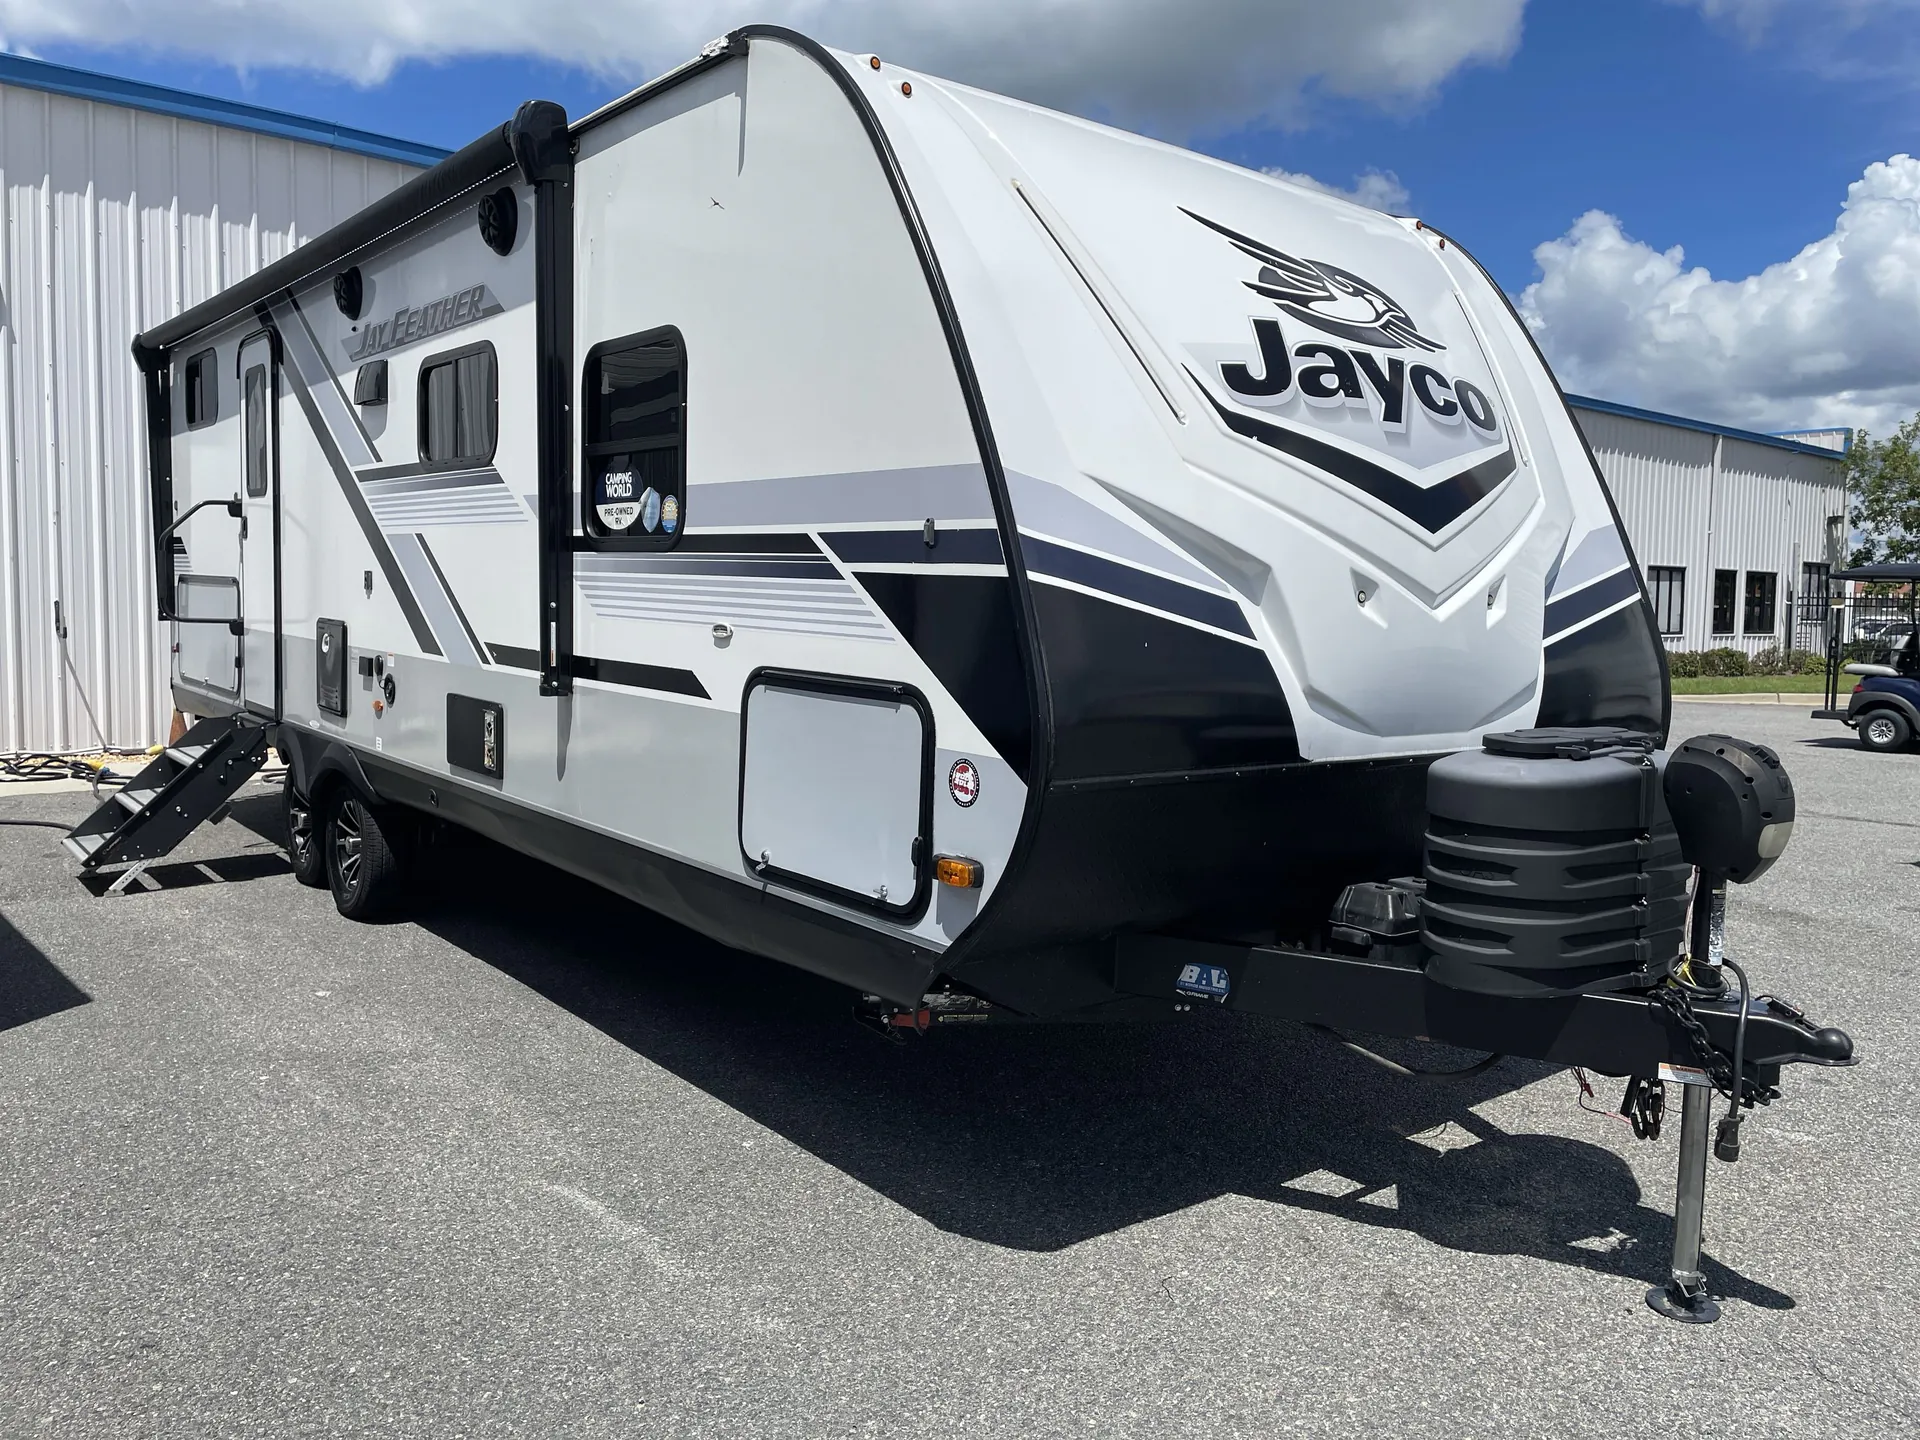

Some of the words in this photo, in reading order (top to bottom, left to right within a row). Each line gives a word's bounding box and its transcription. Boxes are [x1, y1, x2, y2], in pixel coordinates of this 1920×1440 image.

[353, 320, 390, 358] JAY
[390, 282, 486, 347] FEATHER
[1217, 315, 1500, 437] Jayco
[605, 472, 632, 484] CAMPING
[605, 483, 633, 498] WORLD
[604, 507, 634, 517] PRE-OWNED
[615, 517, 622, 525] RV
